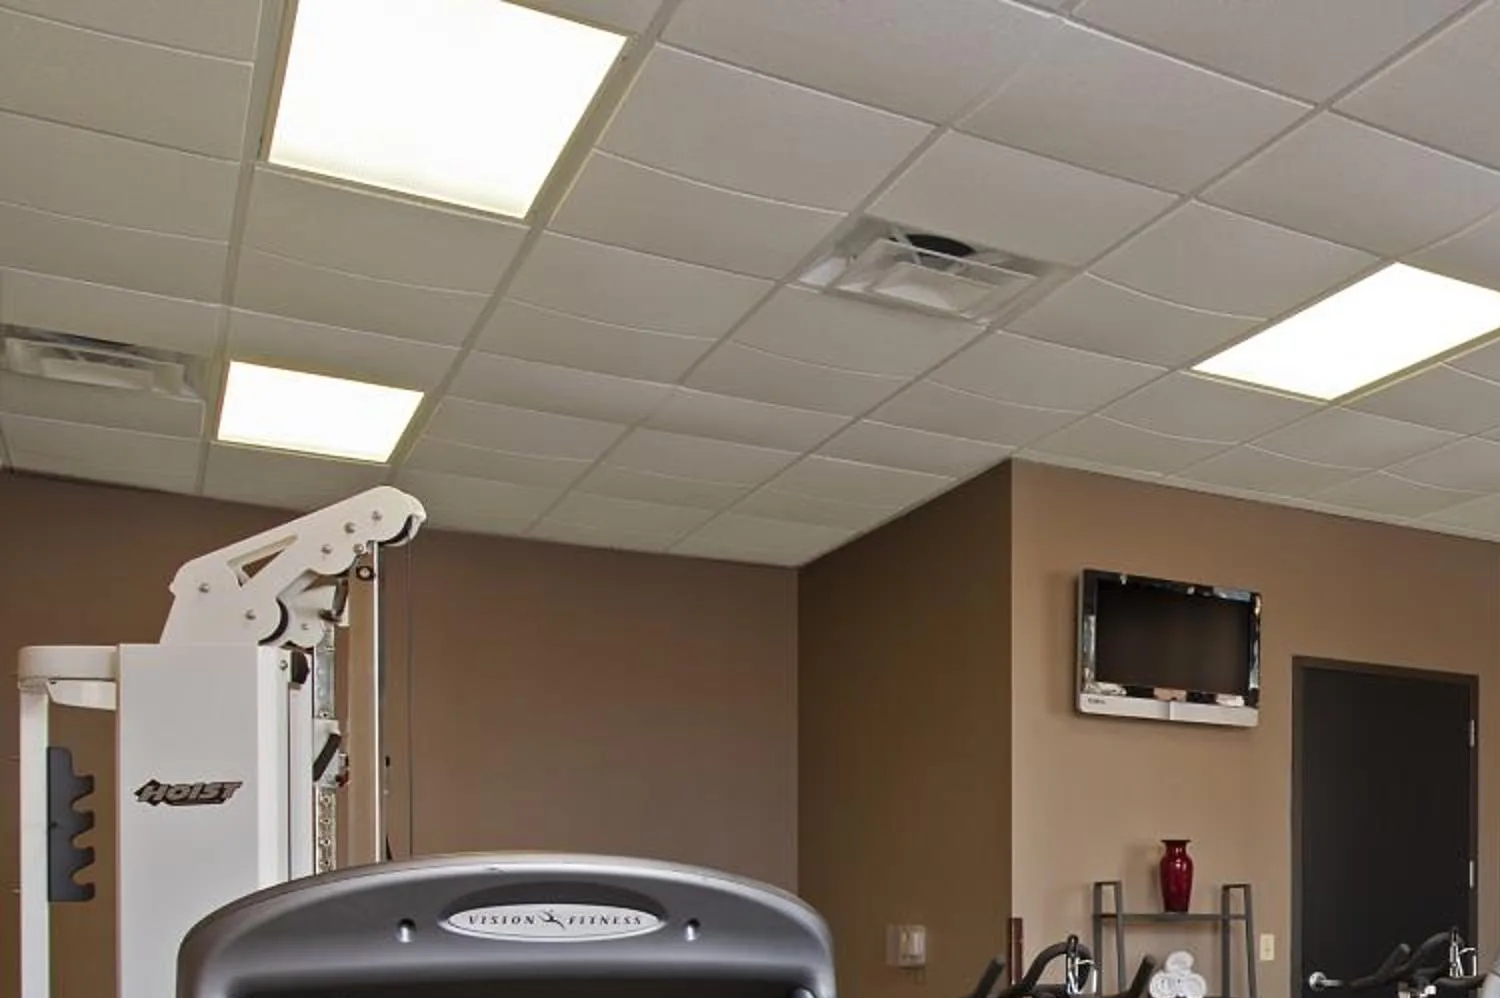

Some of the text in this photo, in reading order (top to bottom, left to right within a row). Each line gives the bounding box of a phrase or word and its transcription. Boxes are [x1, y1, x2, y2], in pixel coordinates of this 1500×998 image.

[139, 781, 243, 802] HOIST
[469, 914, 642, 925] VISION FITNESS
